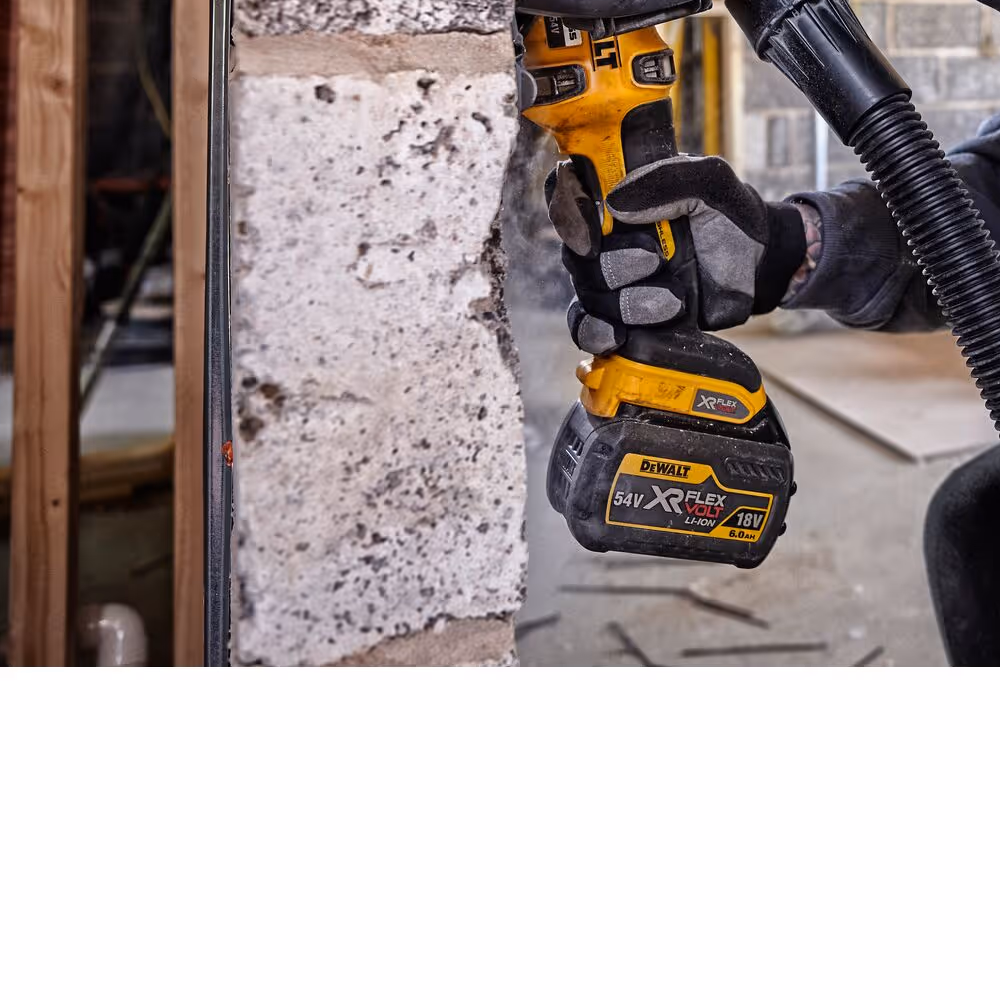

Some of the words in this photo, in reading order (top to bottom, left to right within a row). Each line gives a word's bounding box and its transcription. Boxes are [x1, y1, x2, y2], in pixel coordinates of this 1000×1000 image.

[697, 395, 716, 410] XR
[716, 398, 738, 408] FLEX
[640, 459, 691, 479] DEWALT
[613, 491, 645, 508] 54V
[643, 485, 684, 515] XR
[685, 490, 728, 507] FLEX
[685, 503, 725, 518] VOLT
[684, 516, 717, 528] LI-ION
[737, 512, 764, 529] 18V
